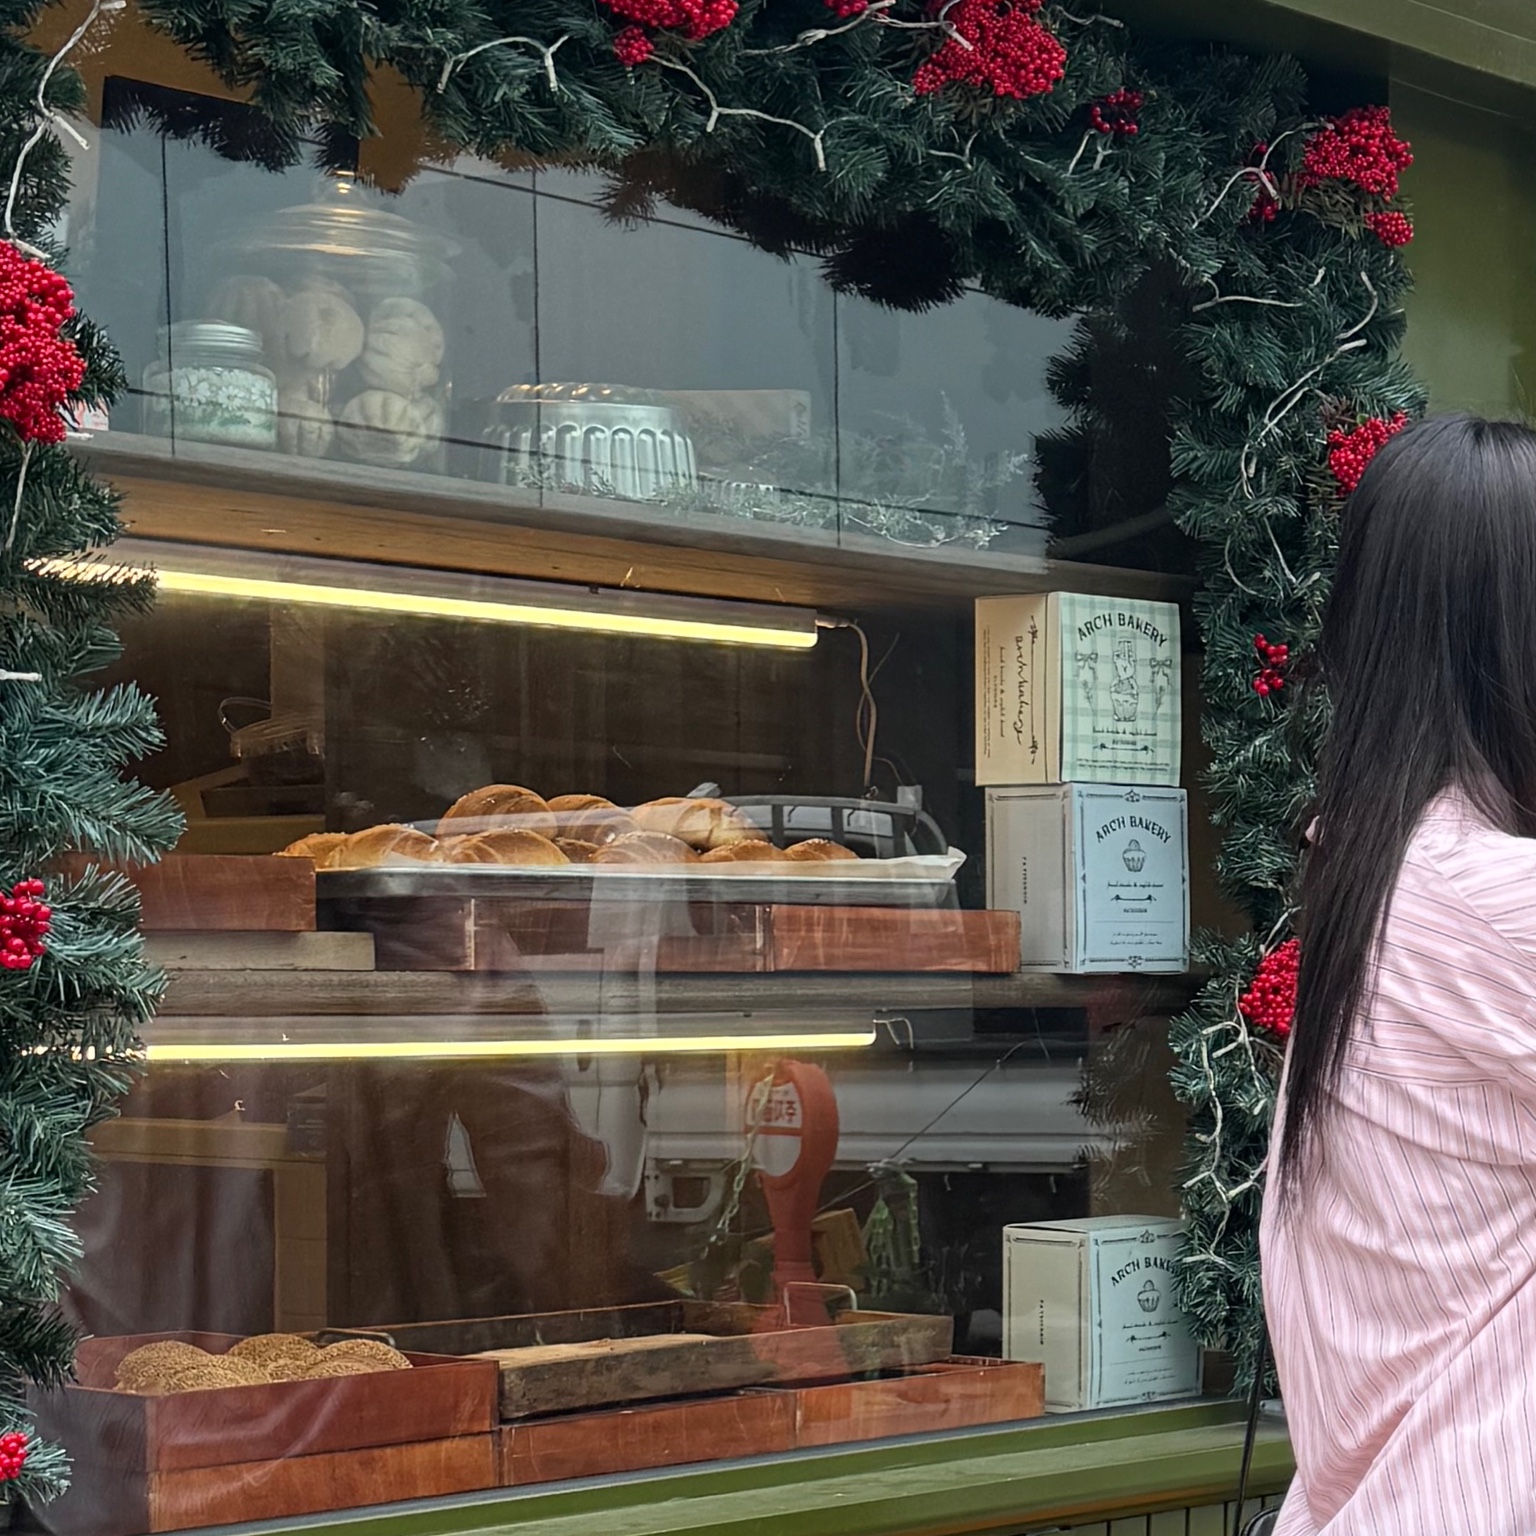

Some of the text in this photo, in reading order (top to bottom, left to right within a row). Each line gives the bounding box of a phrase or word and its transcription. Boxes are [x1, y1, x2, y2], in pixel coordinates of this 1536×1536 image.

[1078, 612, 1168, 648] ARCH BAKERY
[1096, 815, 1172, 844] ARCH BAKERY
[1111, 1258, 1140, 1287] ARCH
